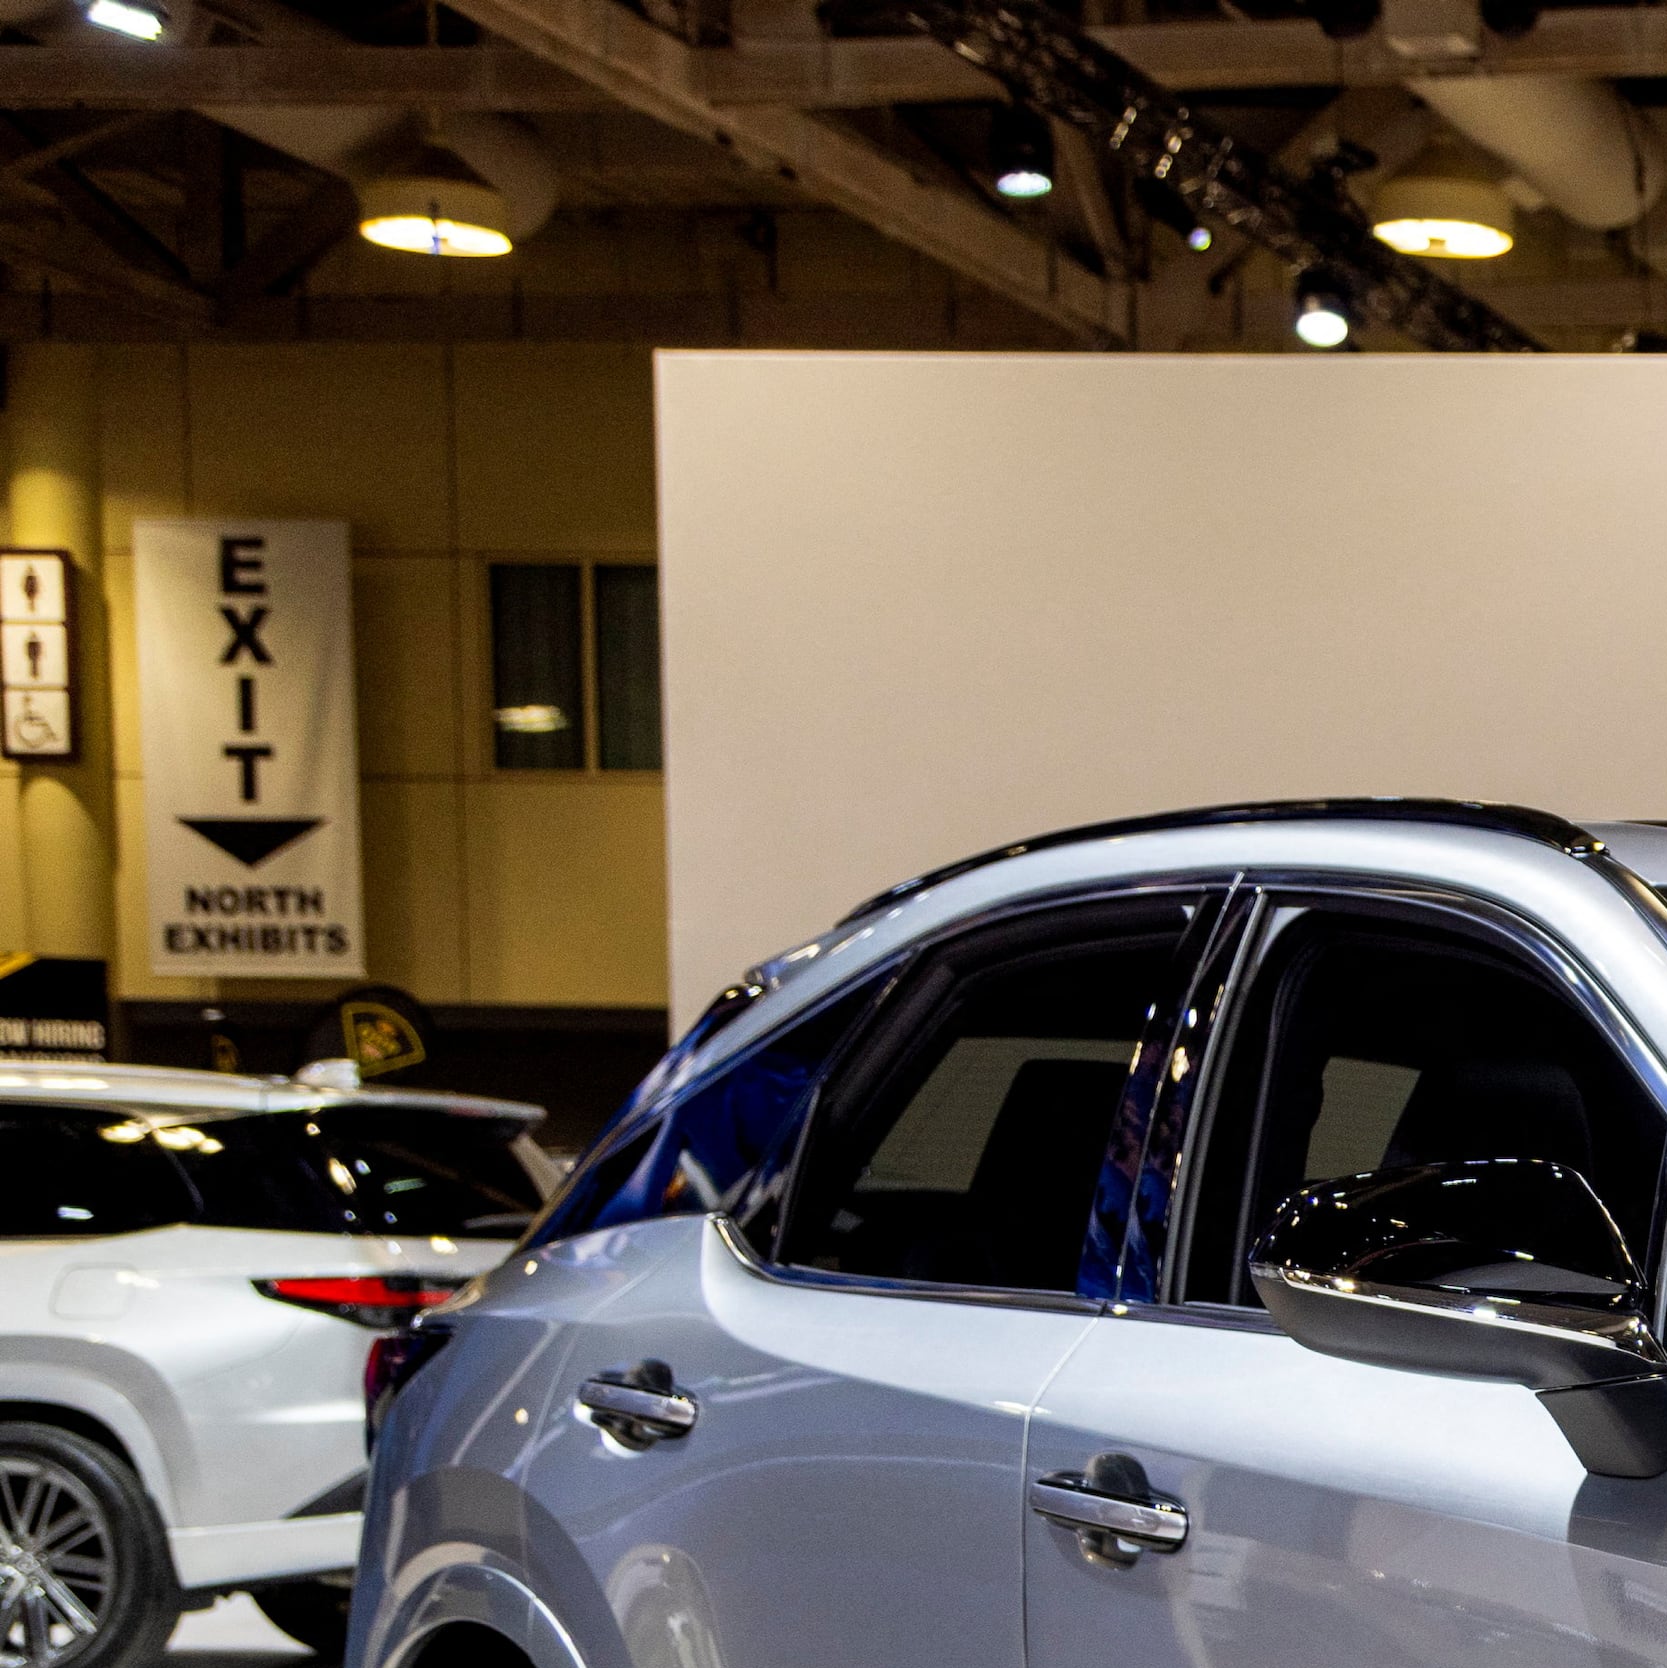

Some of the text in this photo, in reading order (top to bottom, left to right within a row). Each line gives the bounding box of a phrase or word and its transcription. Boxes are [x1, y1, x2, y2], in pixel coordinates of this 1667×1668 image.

[219, 537, 273, 802] EXIT
[185, 885, 325, 917] NORTH
[164, 922, 349, 956] EXHIBITS
[32, 1018, 106, 1050] HIRING
